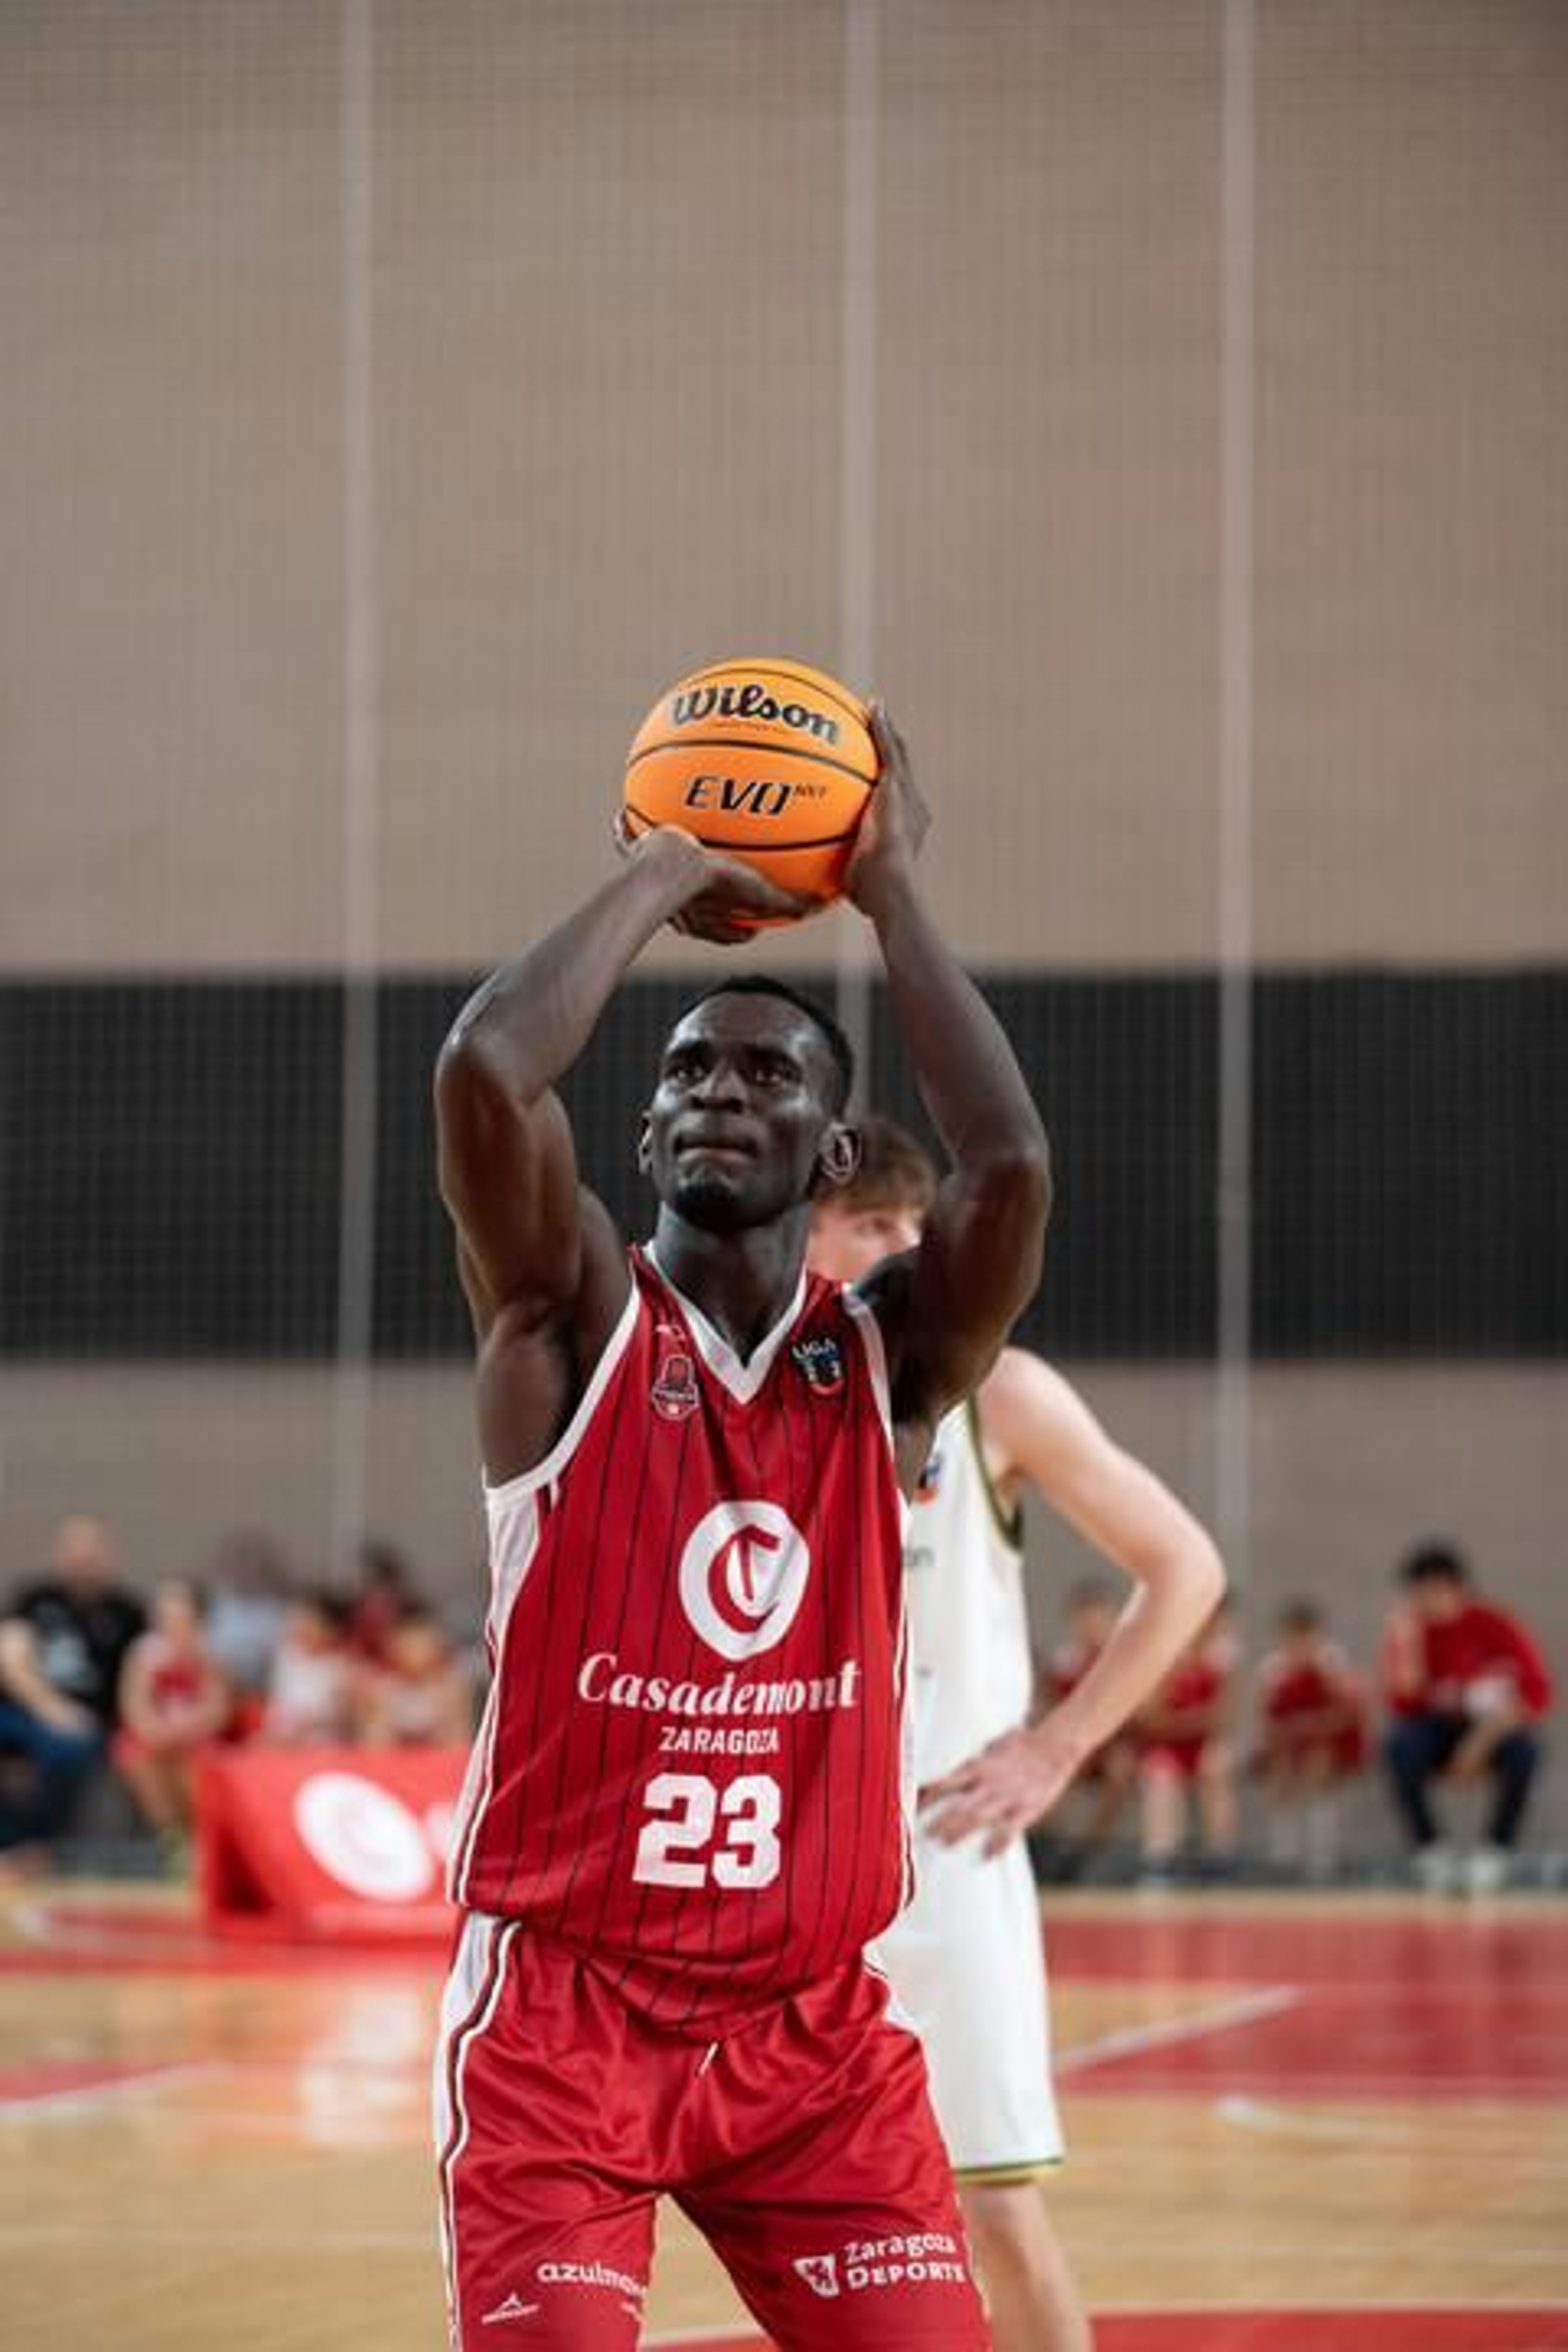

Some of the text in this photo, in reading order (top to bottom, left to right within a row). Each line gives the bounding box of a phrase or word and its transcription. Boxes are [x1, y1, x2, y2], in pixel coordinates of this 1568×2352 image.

[674, 684, 840, 746] Wilson
[685, 776, 792, 815] EVO
[577, 1651, 860, 1715] Casademont
[658, 1726, 781, 1754] ZARAGOZA
[632, 1772, 782, 1887] 23
